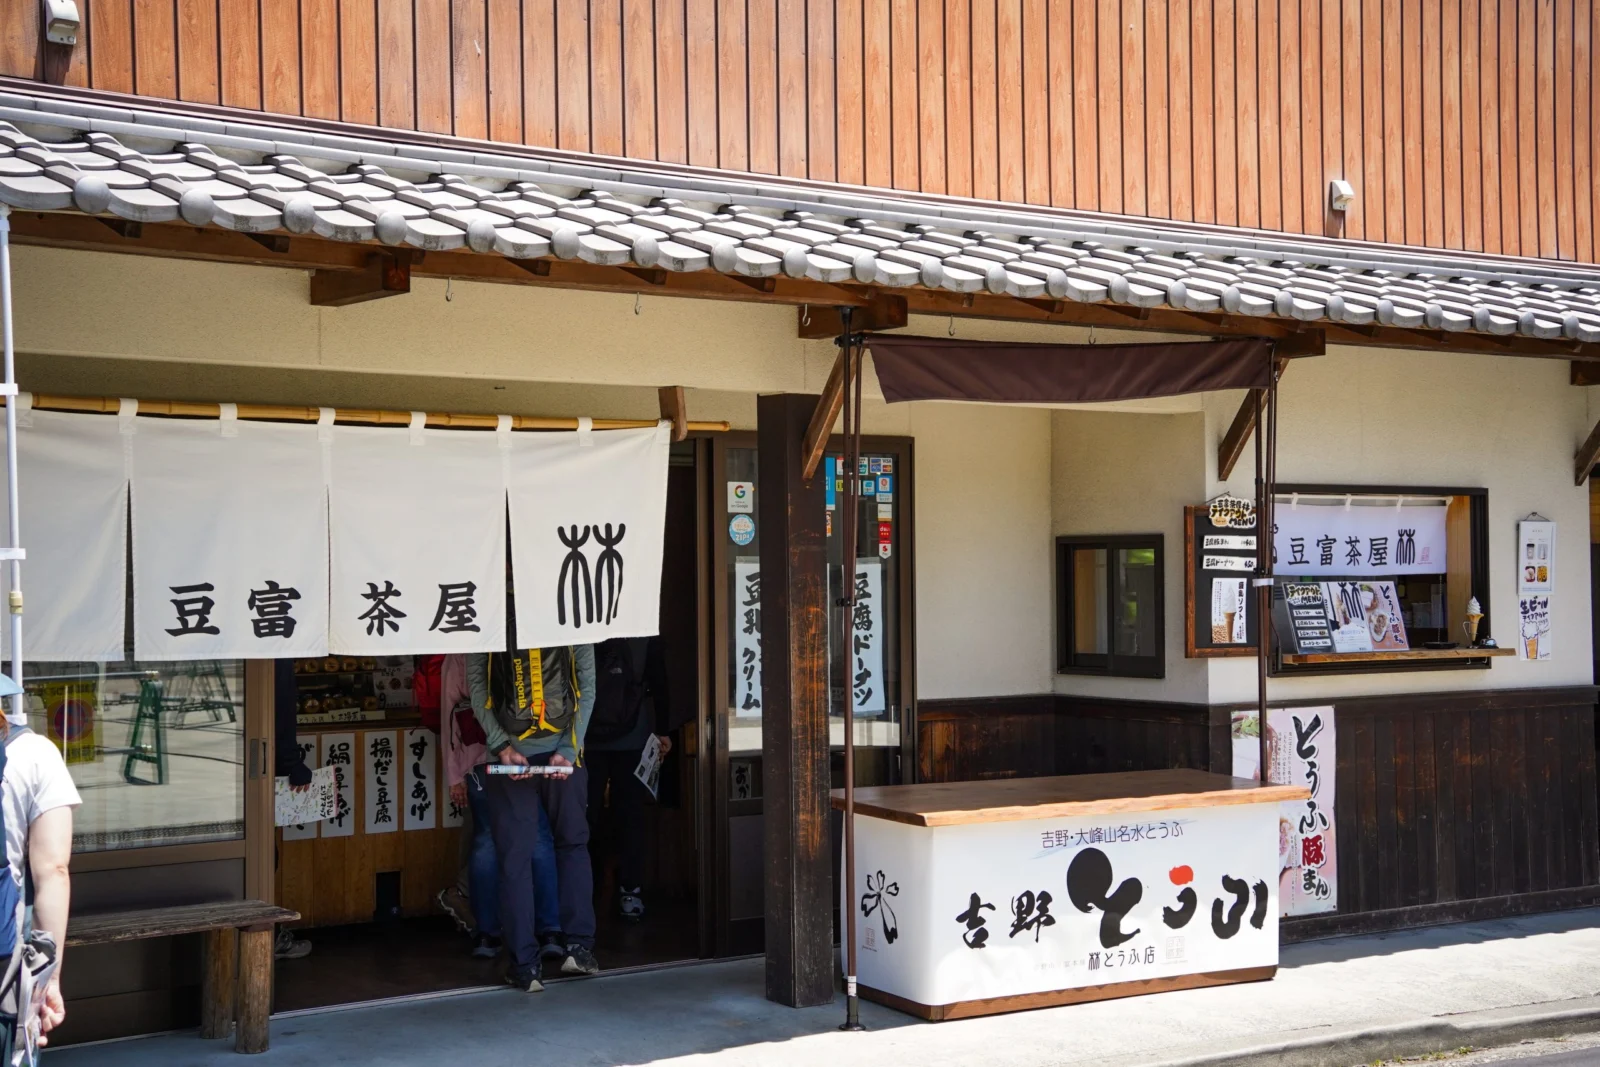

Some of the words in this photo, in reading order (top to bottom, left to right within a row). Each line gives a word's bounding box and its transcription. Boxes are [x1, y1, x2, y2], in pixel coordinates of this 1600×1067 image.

[1211, 504, 1247, 520] テイクアウト
[1228, 515, 1256, 526] MENU
[513, 658, 528, 709] patagonia
[369, 737, 393, 826] 揚だし豆腐
[409, 735, 431, 822] すしあげ
